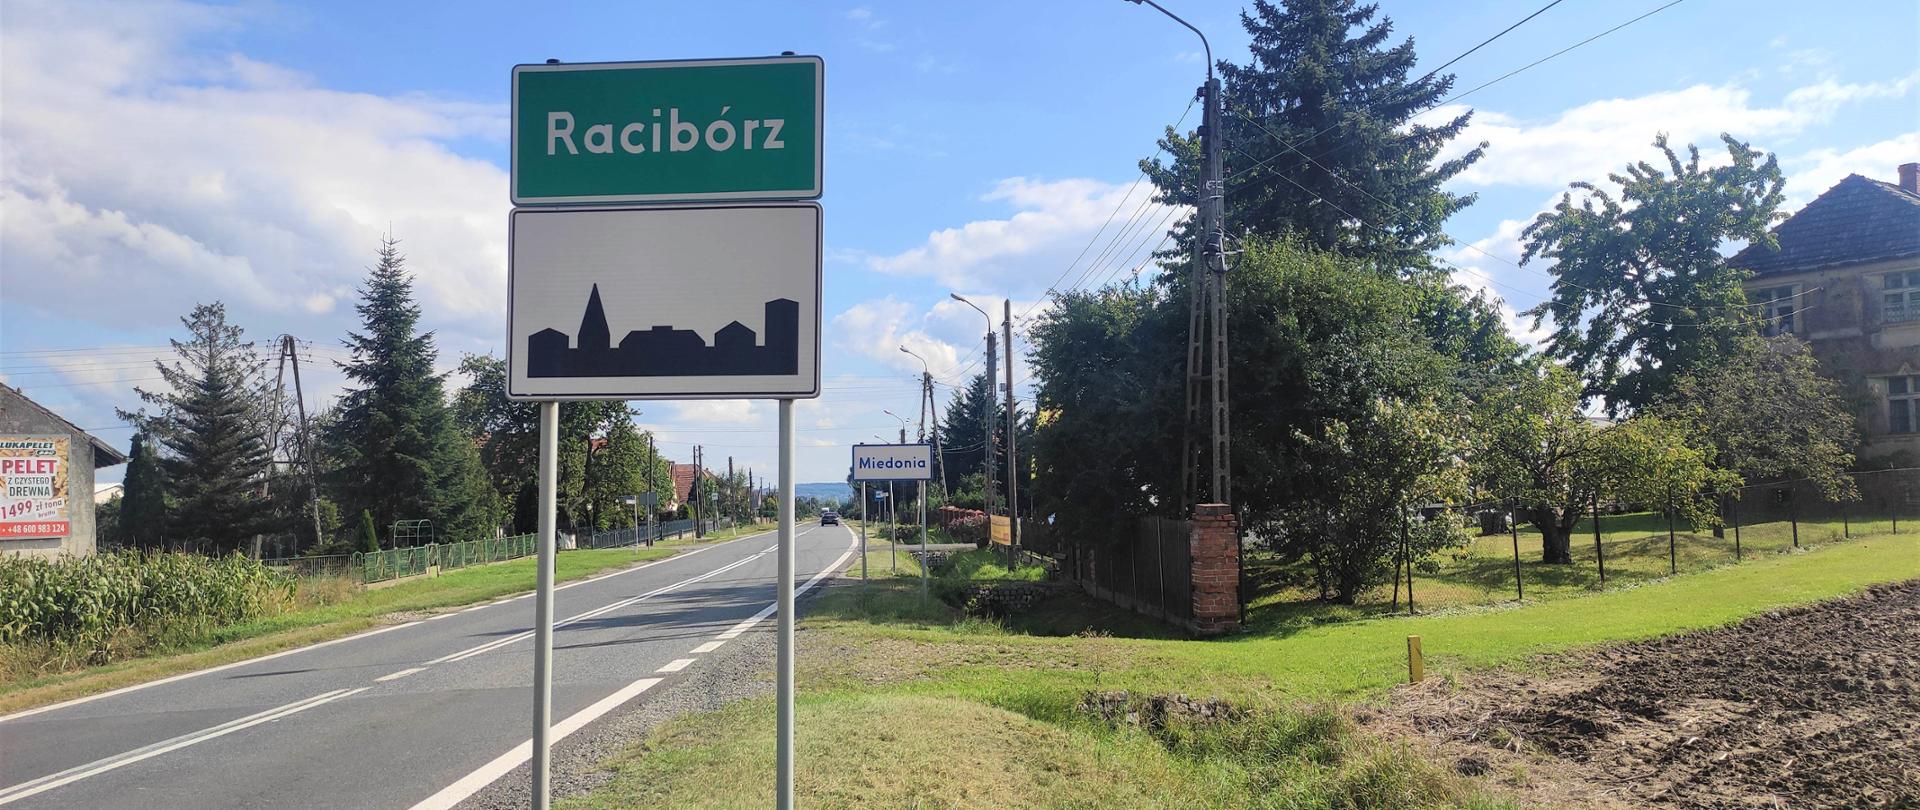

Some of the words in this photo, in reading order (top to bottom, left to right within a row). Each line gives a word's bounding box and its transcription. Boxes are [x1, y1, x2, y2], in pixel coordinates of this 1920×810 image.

[547, 106, 785, 155] Racibórz
[2, 460, 57, 474] PELET
[859, 456, 926, 469] Miedonia
[14, 477, 50, 485] CZYSTEGO
[9, 486, 51, 497] DREWNA
[1, 500, 33, 519] 1499
[8, 525, 22, 534] +48
[23, 524, 37, 533] 600
[38, 524, 51, 533] 983
[52, 523, 65, 533] 124
